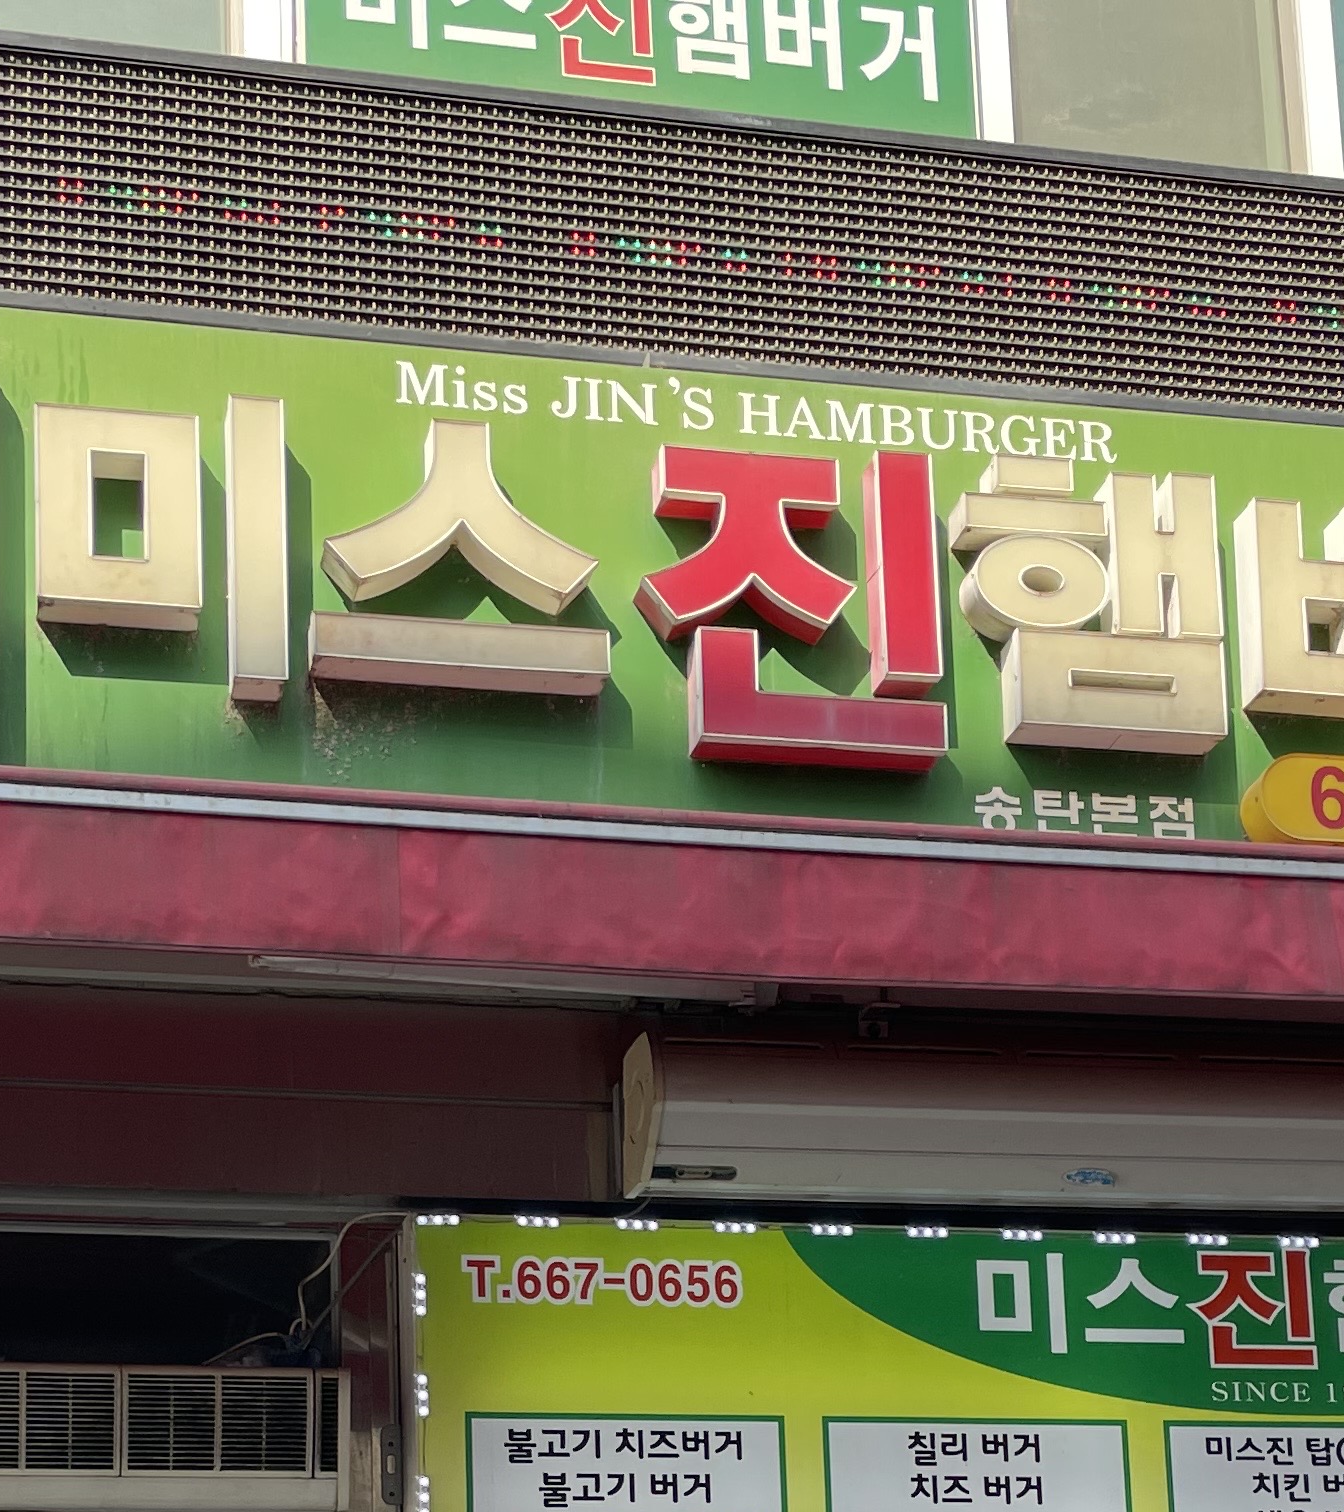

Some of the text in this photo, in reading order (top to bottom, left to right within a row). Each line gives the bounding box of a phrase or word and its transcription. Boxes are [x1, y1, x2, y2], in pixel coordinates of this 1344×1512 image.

[396, 360, 1117, 463] Miss JIN'S HAMBURGER
[974, 786, 1196, 841] 송탄본점
[466, 1259, 739, 1302] T.667-0656
[1211, 1382, 1310, 1403] SINCE
[504, 1428, 744, 1463] 불고기 치즈버거
[907, 1432, 1040, 1463] 칠리 버거
[1206, 1437, 1294, 1464] 미스진
[538, 1472, 712, 1507] 불고기 버거
[910, 1476, 1043, 1505] 치즈 버거
[1253, 1473, 1312, 1501] 치킨
